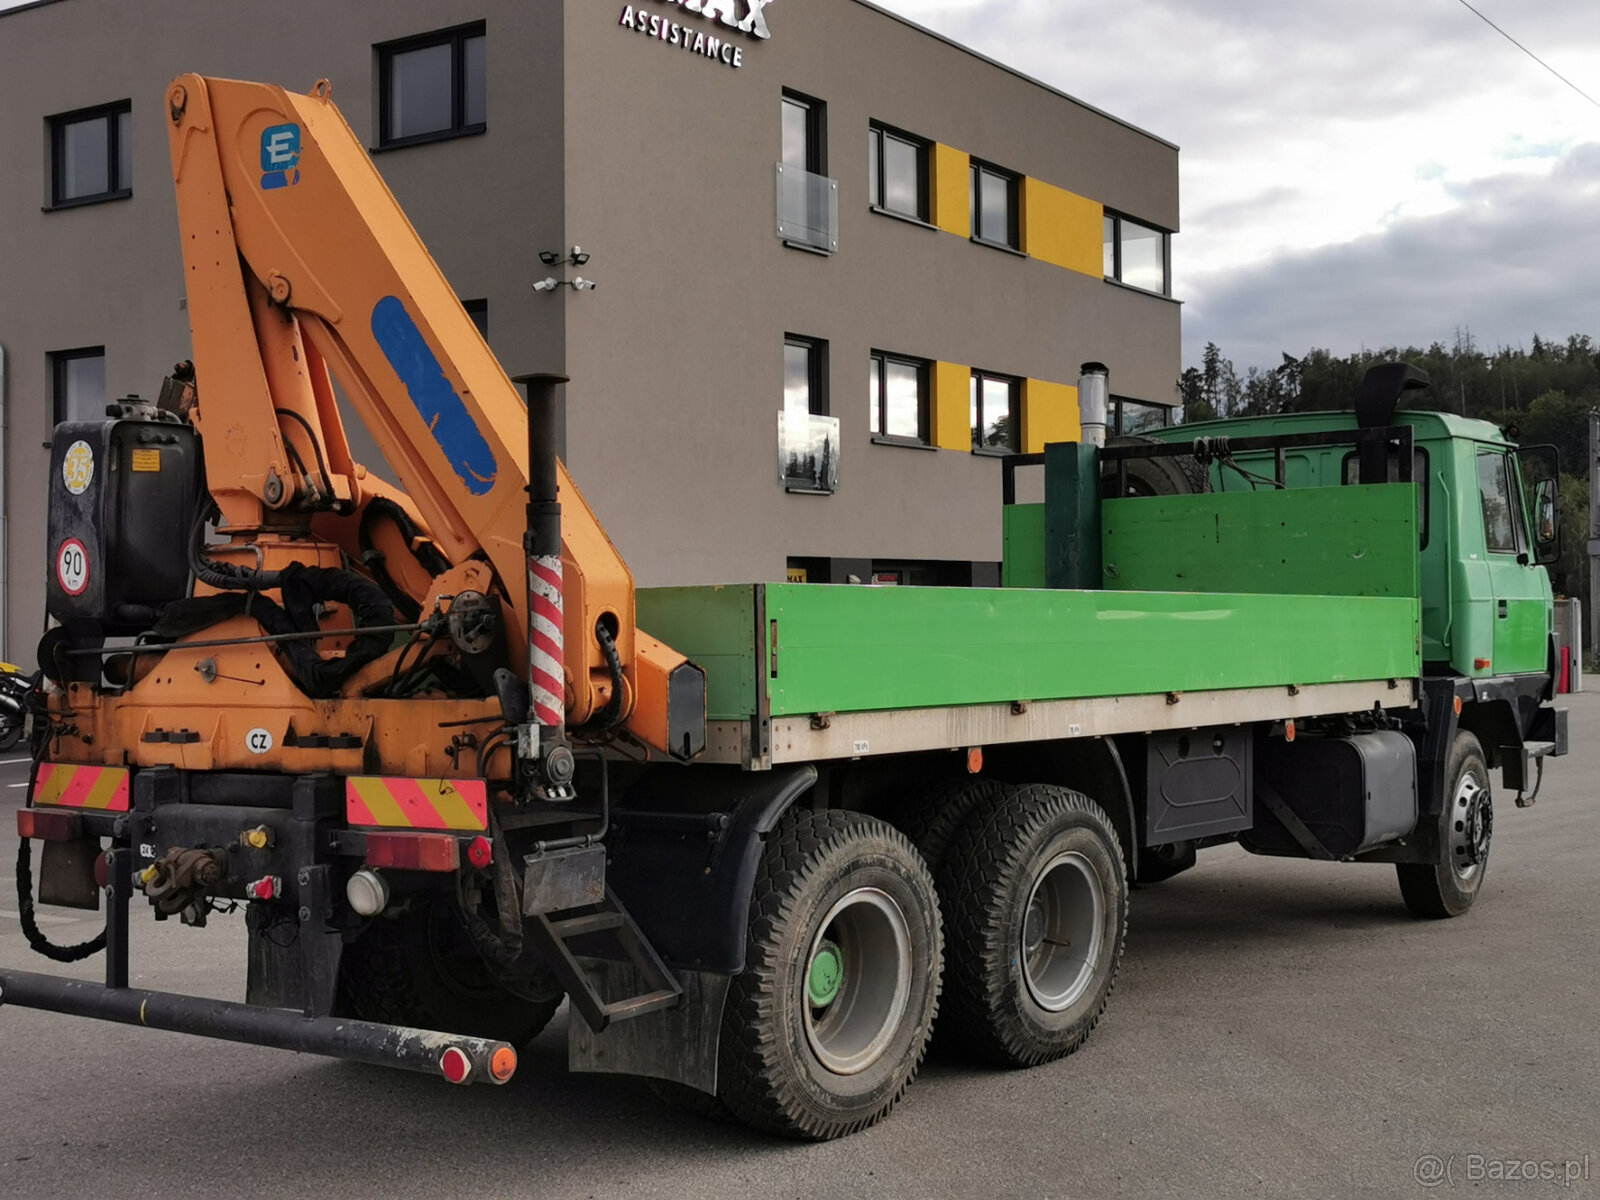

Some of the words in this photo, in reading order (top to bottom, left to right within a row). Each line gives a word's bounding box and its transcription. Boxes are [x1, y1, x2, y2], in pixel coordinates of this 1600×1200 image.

[620, 5, 742, 68] ASSISTANCE
[64, 550, 81, 576] 90
[251, 733, 267, 749] CZ
